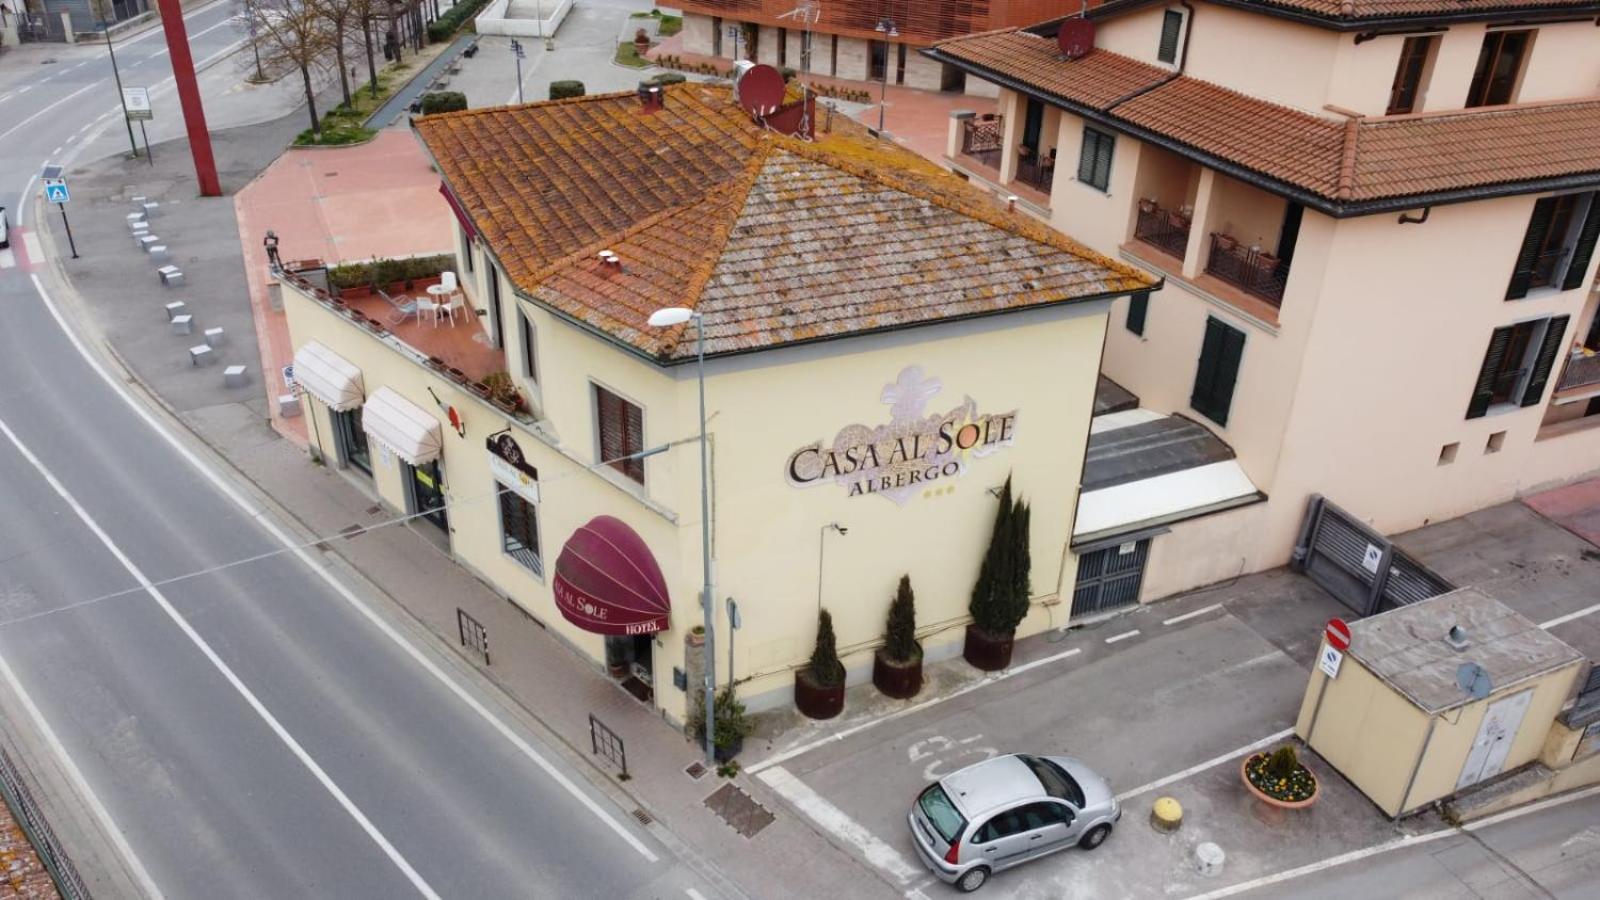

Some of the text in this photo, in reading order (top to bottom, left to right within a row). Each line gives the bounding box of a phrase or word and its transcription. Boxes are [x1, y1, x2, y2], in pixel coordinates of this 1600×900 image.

[789, 414, 1015, 483] CASA AL SOLE
[849, 462, 959, 497] ALBERGO
[576, 596, 608, 620] SOLE
[626, 620, 660, 635] HOTEL
